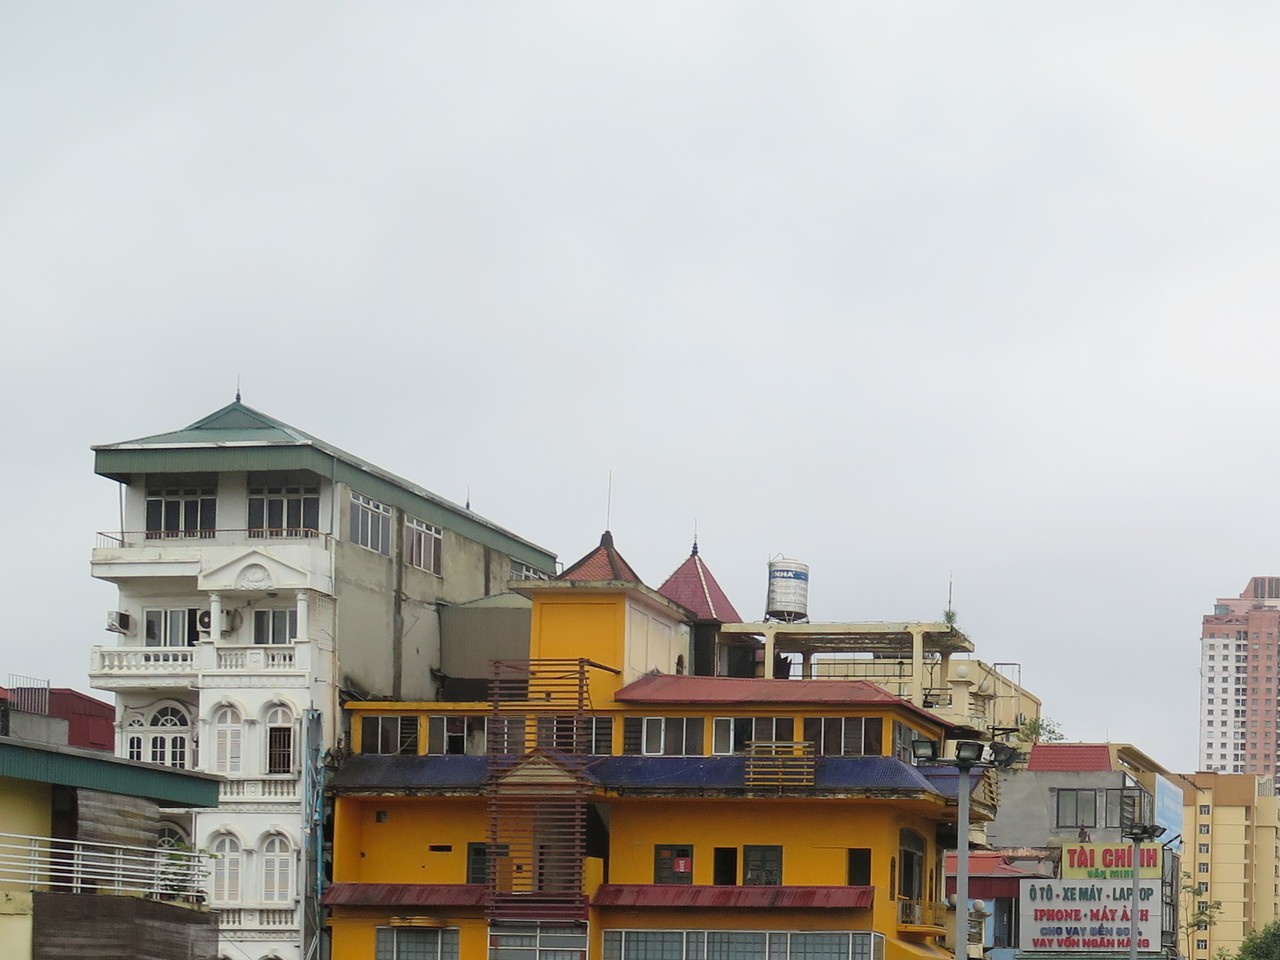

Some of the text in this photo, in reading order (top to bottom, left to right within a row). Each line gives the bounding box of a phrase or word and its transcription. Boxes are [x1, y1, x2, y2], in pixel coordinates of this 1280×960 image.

[1068, 846, 1094, 868] TÀI
[1029, 884, 1153, 901] Ô TÔ XE MÁY LAPOP
[1034, 908, 1081, 921] IPHONE
[1090, 905, 1117, 921] MÁY
[1040, 926, 1062, 936] CHO
[1065, 926, 1086, 936] VAY
[1090, 923, 1113, 936] ĐẾN
[1032, 938, 1054, 948] VAY
[1057, 936, 1080, 948] VỐN
[1082, 936, 1115, 948] NGÂN
